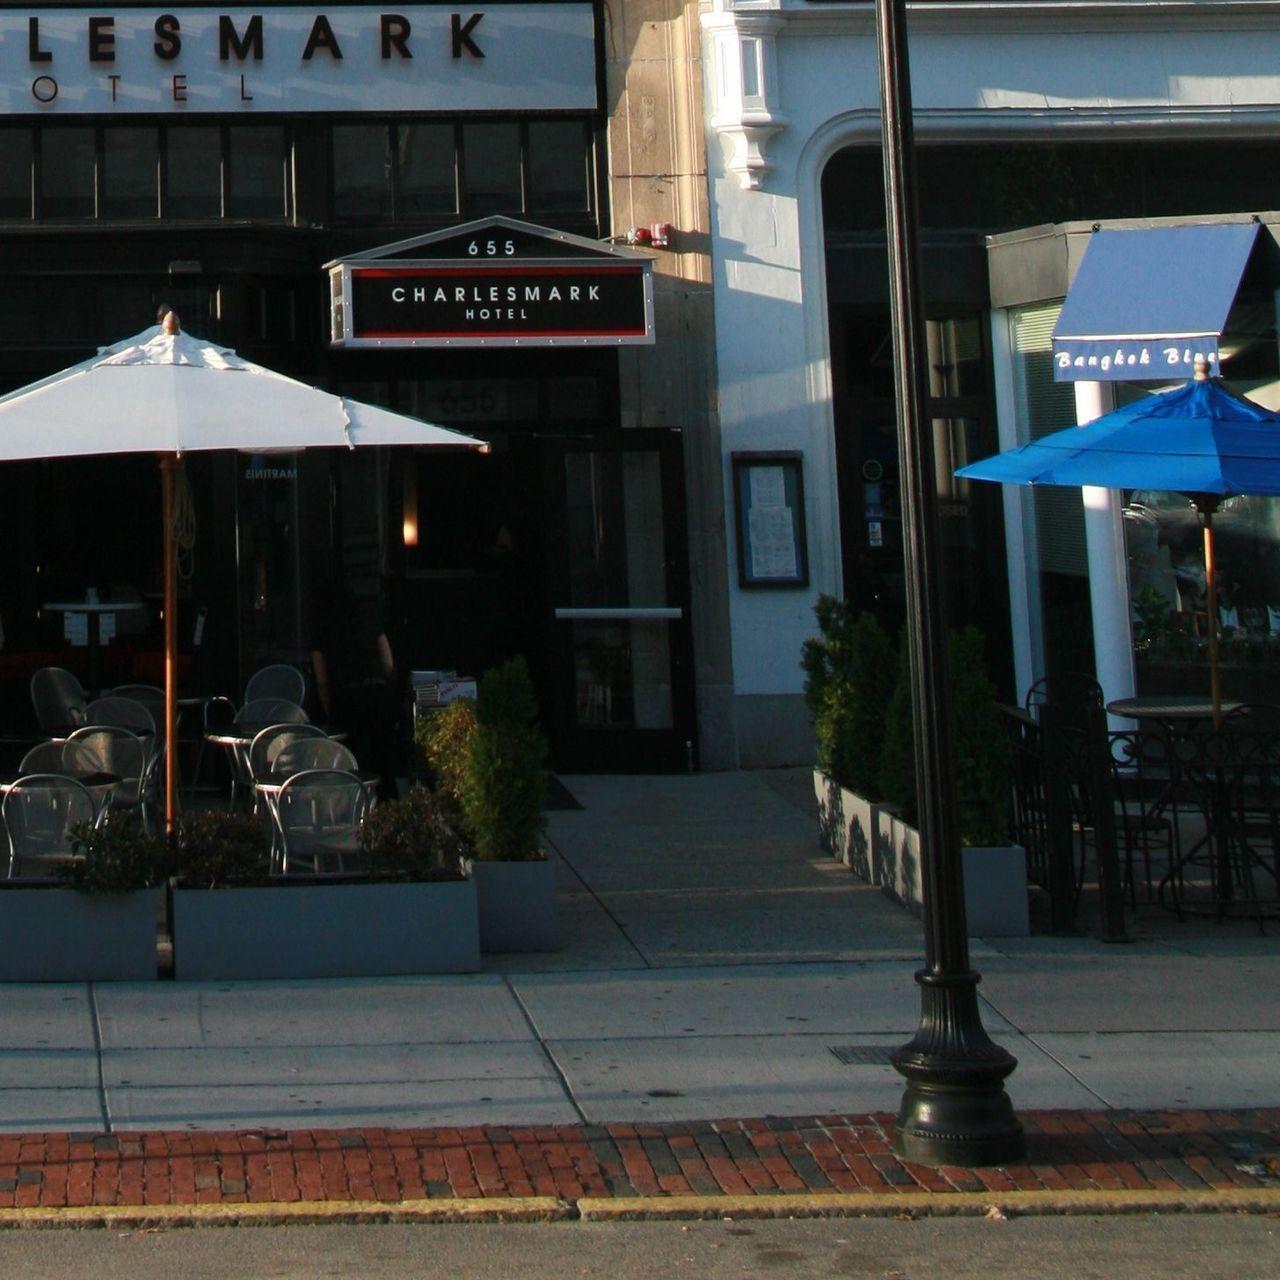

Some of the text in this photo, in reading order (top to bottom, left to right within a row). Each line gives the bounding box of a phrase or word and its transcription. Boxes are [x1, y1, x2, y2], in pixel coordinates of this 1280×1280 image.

[468, 240, 516, 255] 655
[391, 286, 600, 303] CHARLESMARK
[465, 308, 528, 320] HOTEL
[1054, 348, 1151, 371] Bangkok
